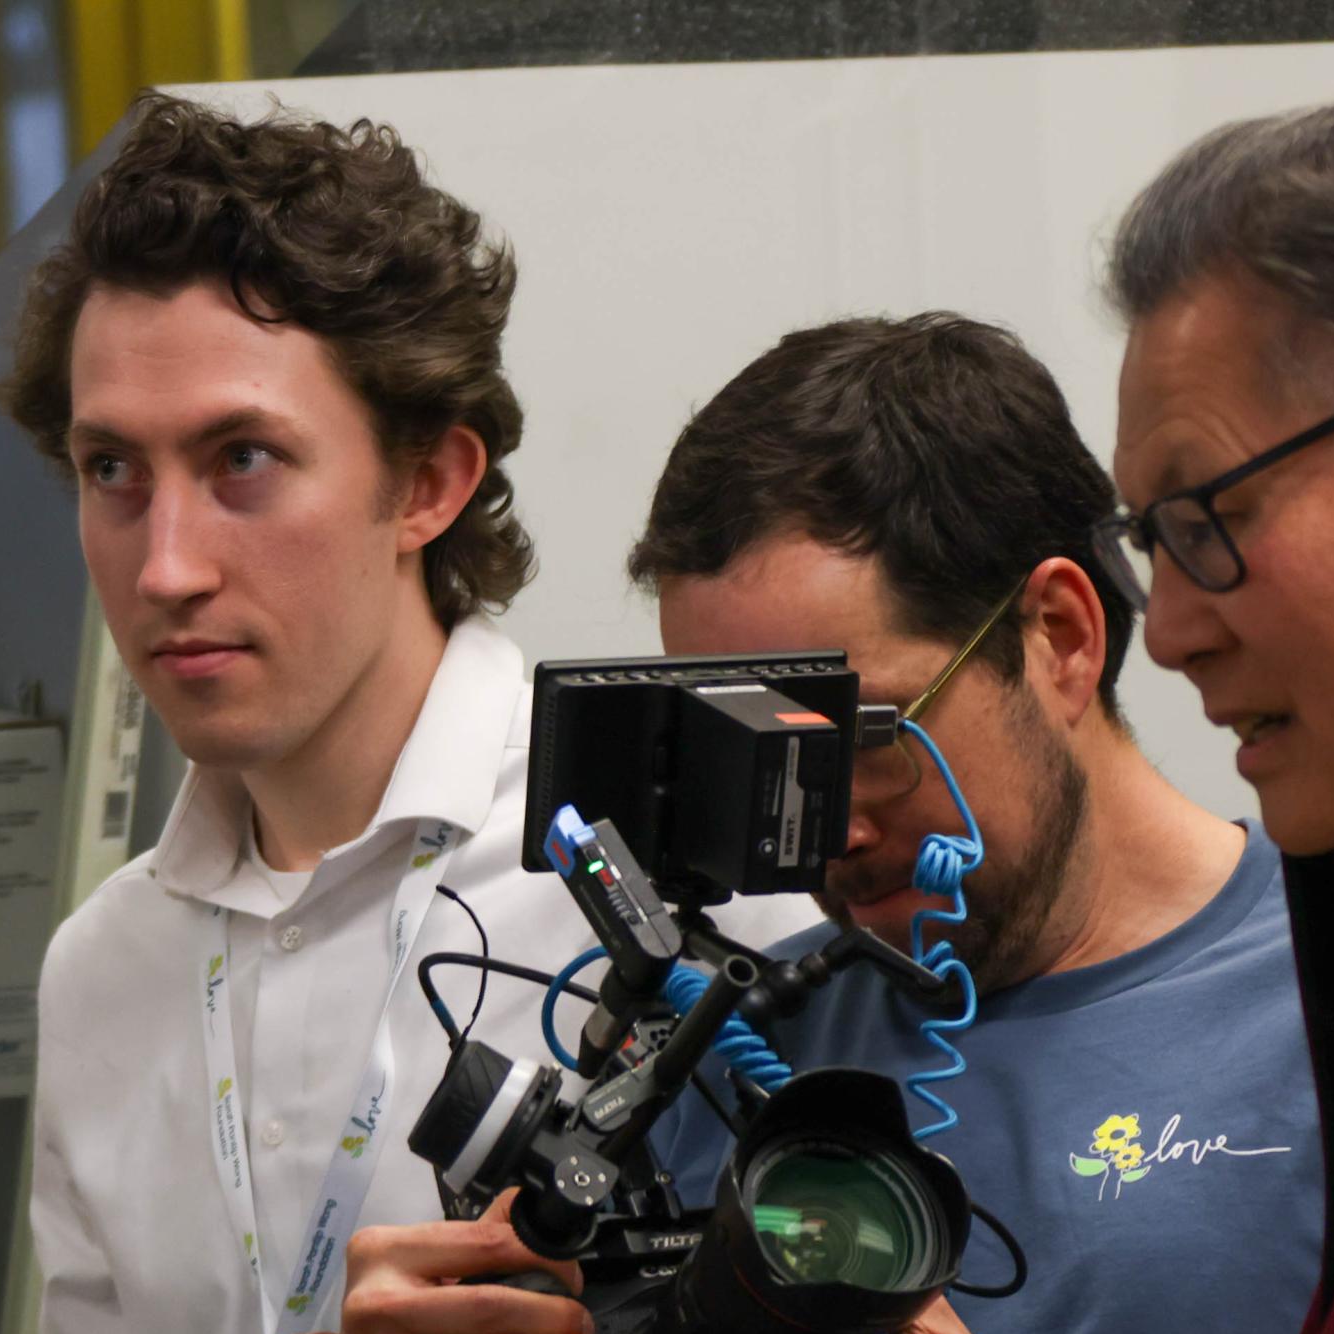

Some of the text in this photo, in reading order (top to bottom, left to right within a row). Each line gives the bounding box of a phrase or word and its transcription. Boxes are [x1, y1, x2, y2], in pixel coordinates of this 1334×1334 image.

[784, 817, 796, 856] SWIT
[351, 1069, 386, 1136] love
[216, 1105, 228, 1160] Foundation
[1143, 1113, 1293, 1165] love
[317, 1198, 338, 1228] Wong
[309, 1236, 336, 1293] Foundation
